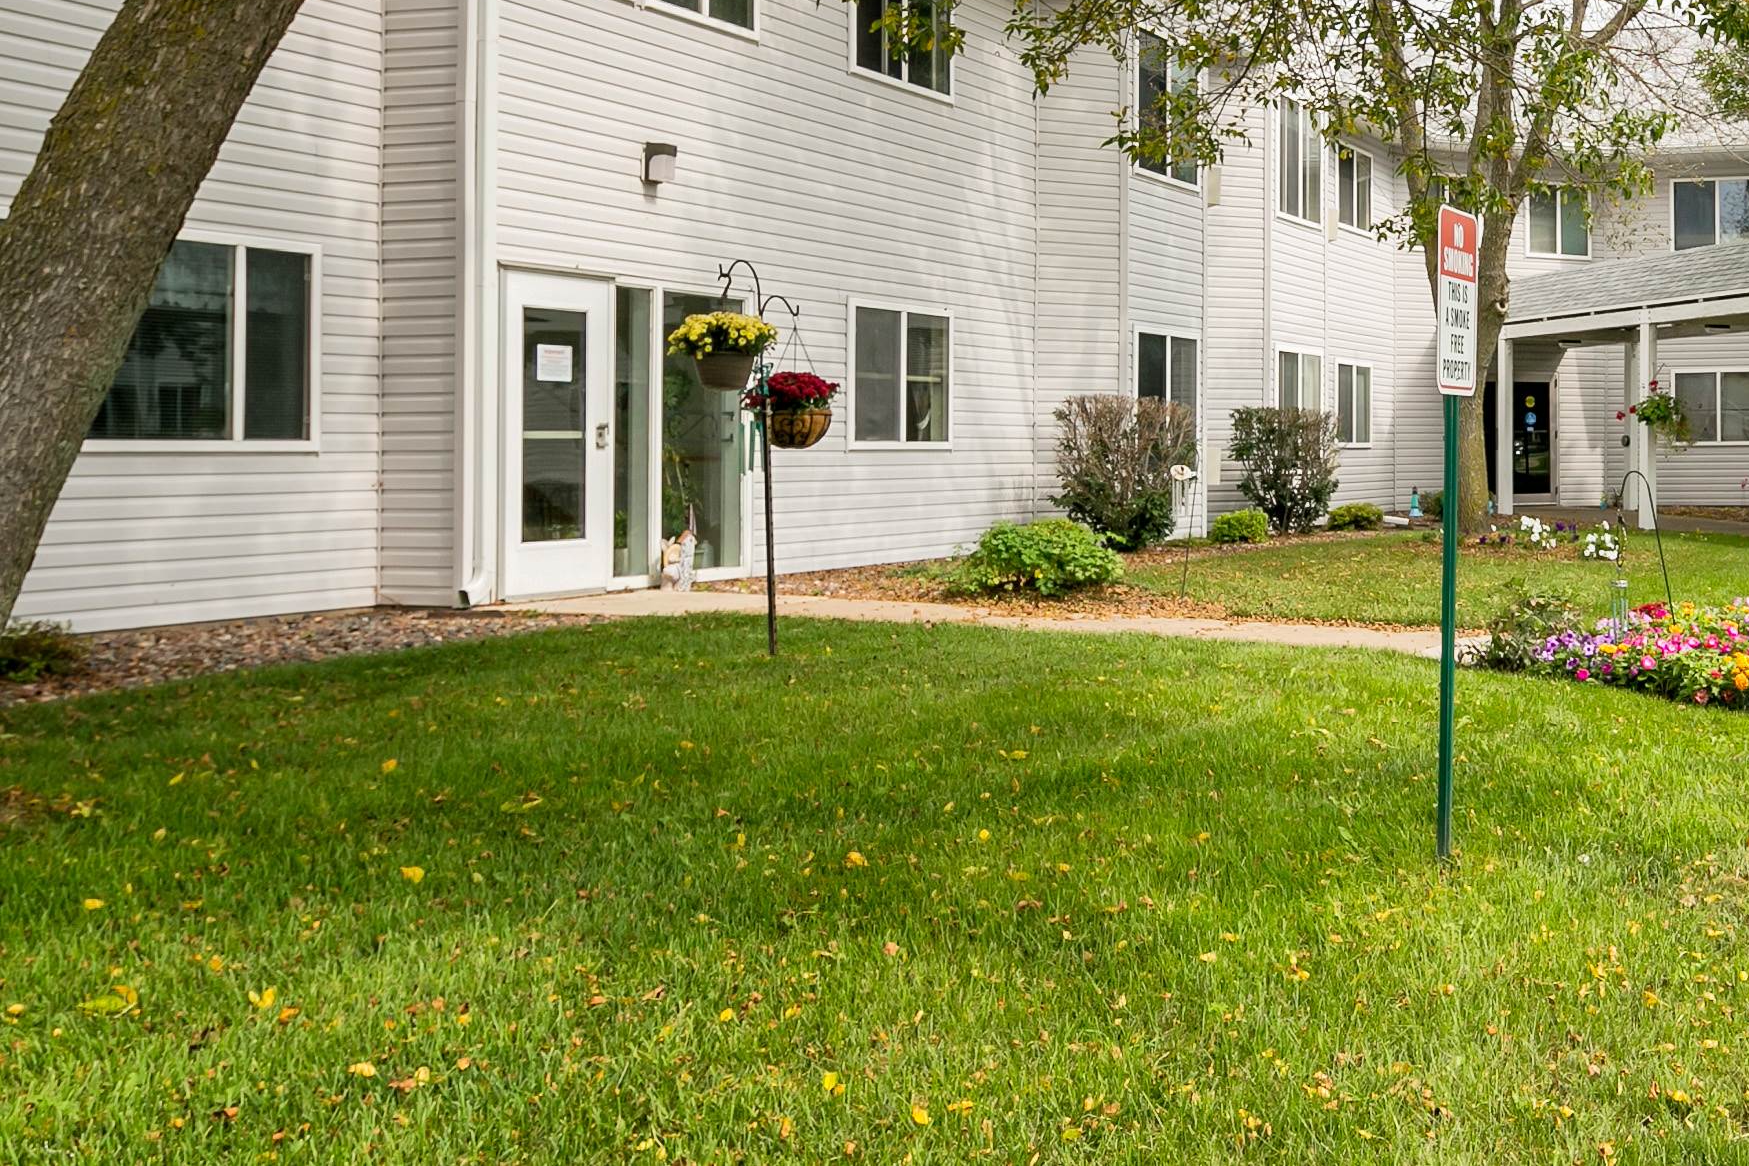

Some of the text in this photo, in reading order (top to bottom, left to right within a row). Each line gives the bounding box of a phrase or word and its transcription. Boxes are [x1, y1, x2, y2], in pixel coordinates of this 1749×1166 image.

[1453, 222, 1464, 249] NO
[1443, 246, 1474, 277] SMOKING
[1448, 281, 1468, 304] THIS IS
[1450, 307, 1470, 330] SMOKE
[1450, 334, 1465, 354] FREE
[1442, 358, 1471, 382] PROPERTY
